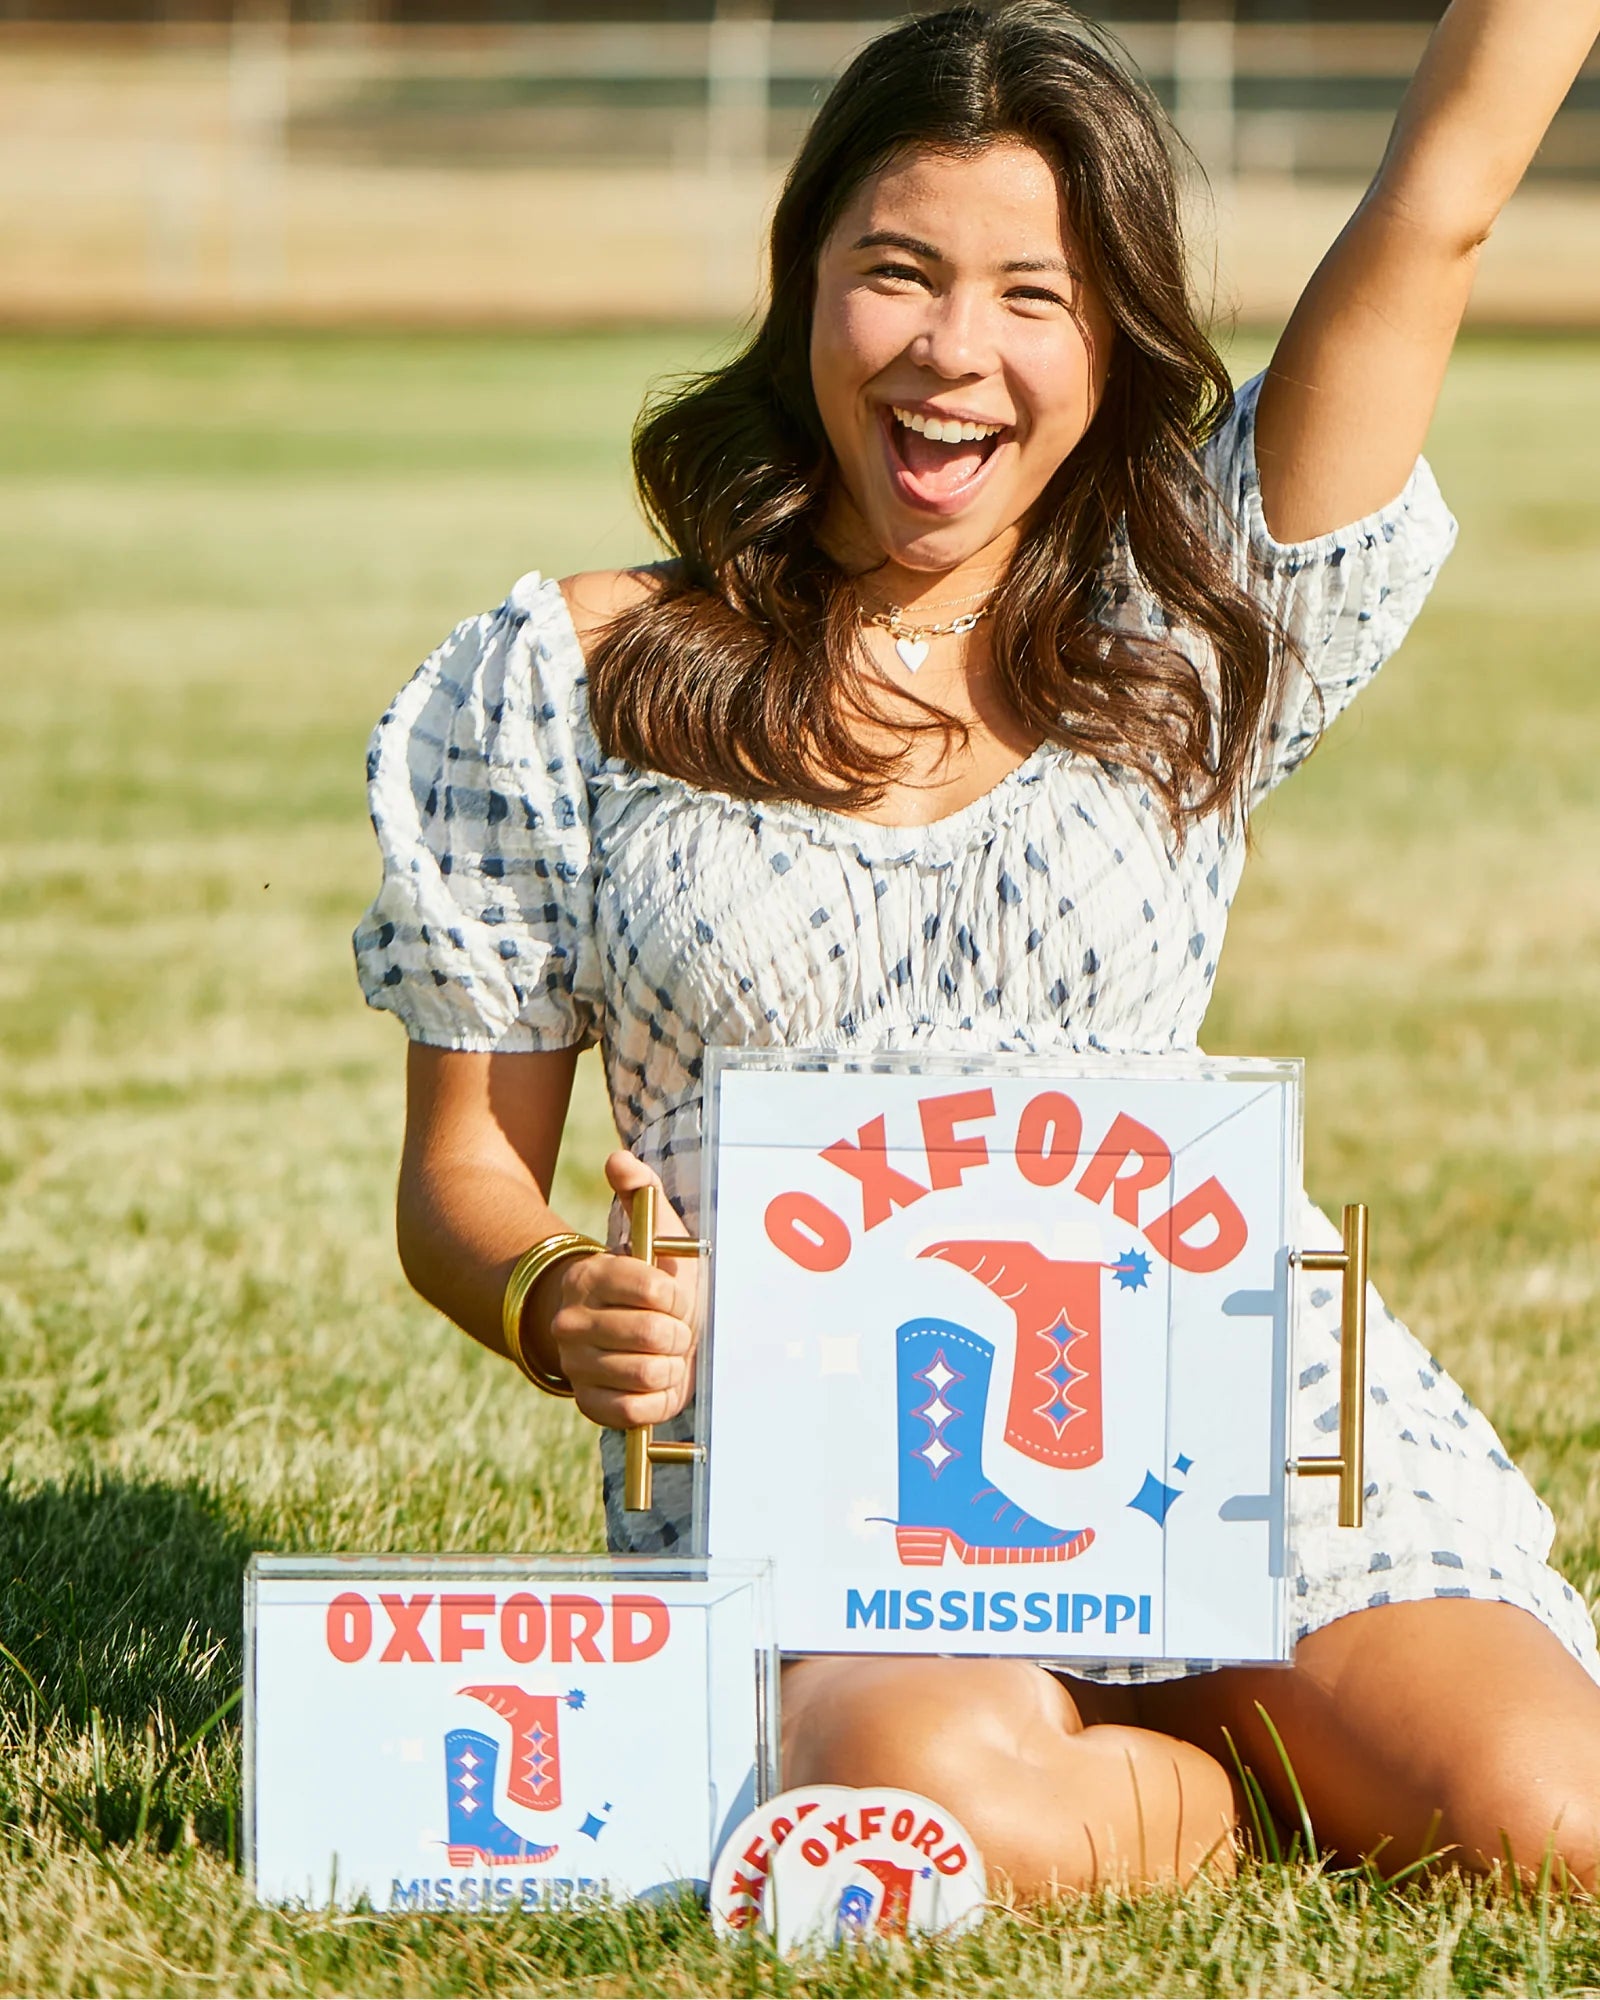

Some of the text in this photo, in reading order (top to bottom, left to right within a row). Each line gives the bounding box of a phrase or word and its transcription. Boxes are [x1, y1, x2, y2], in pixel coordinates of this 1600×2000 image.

[764, 1087, 1248, 1272] OXFORD
[327, 1592, 670, 1663] OXFORD
[846, 1589, 1151, 1634] MISSISSIPPI
[801, 1806, 967, 1875] OXFORD
